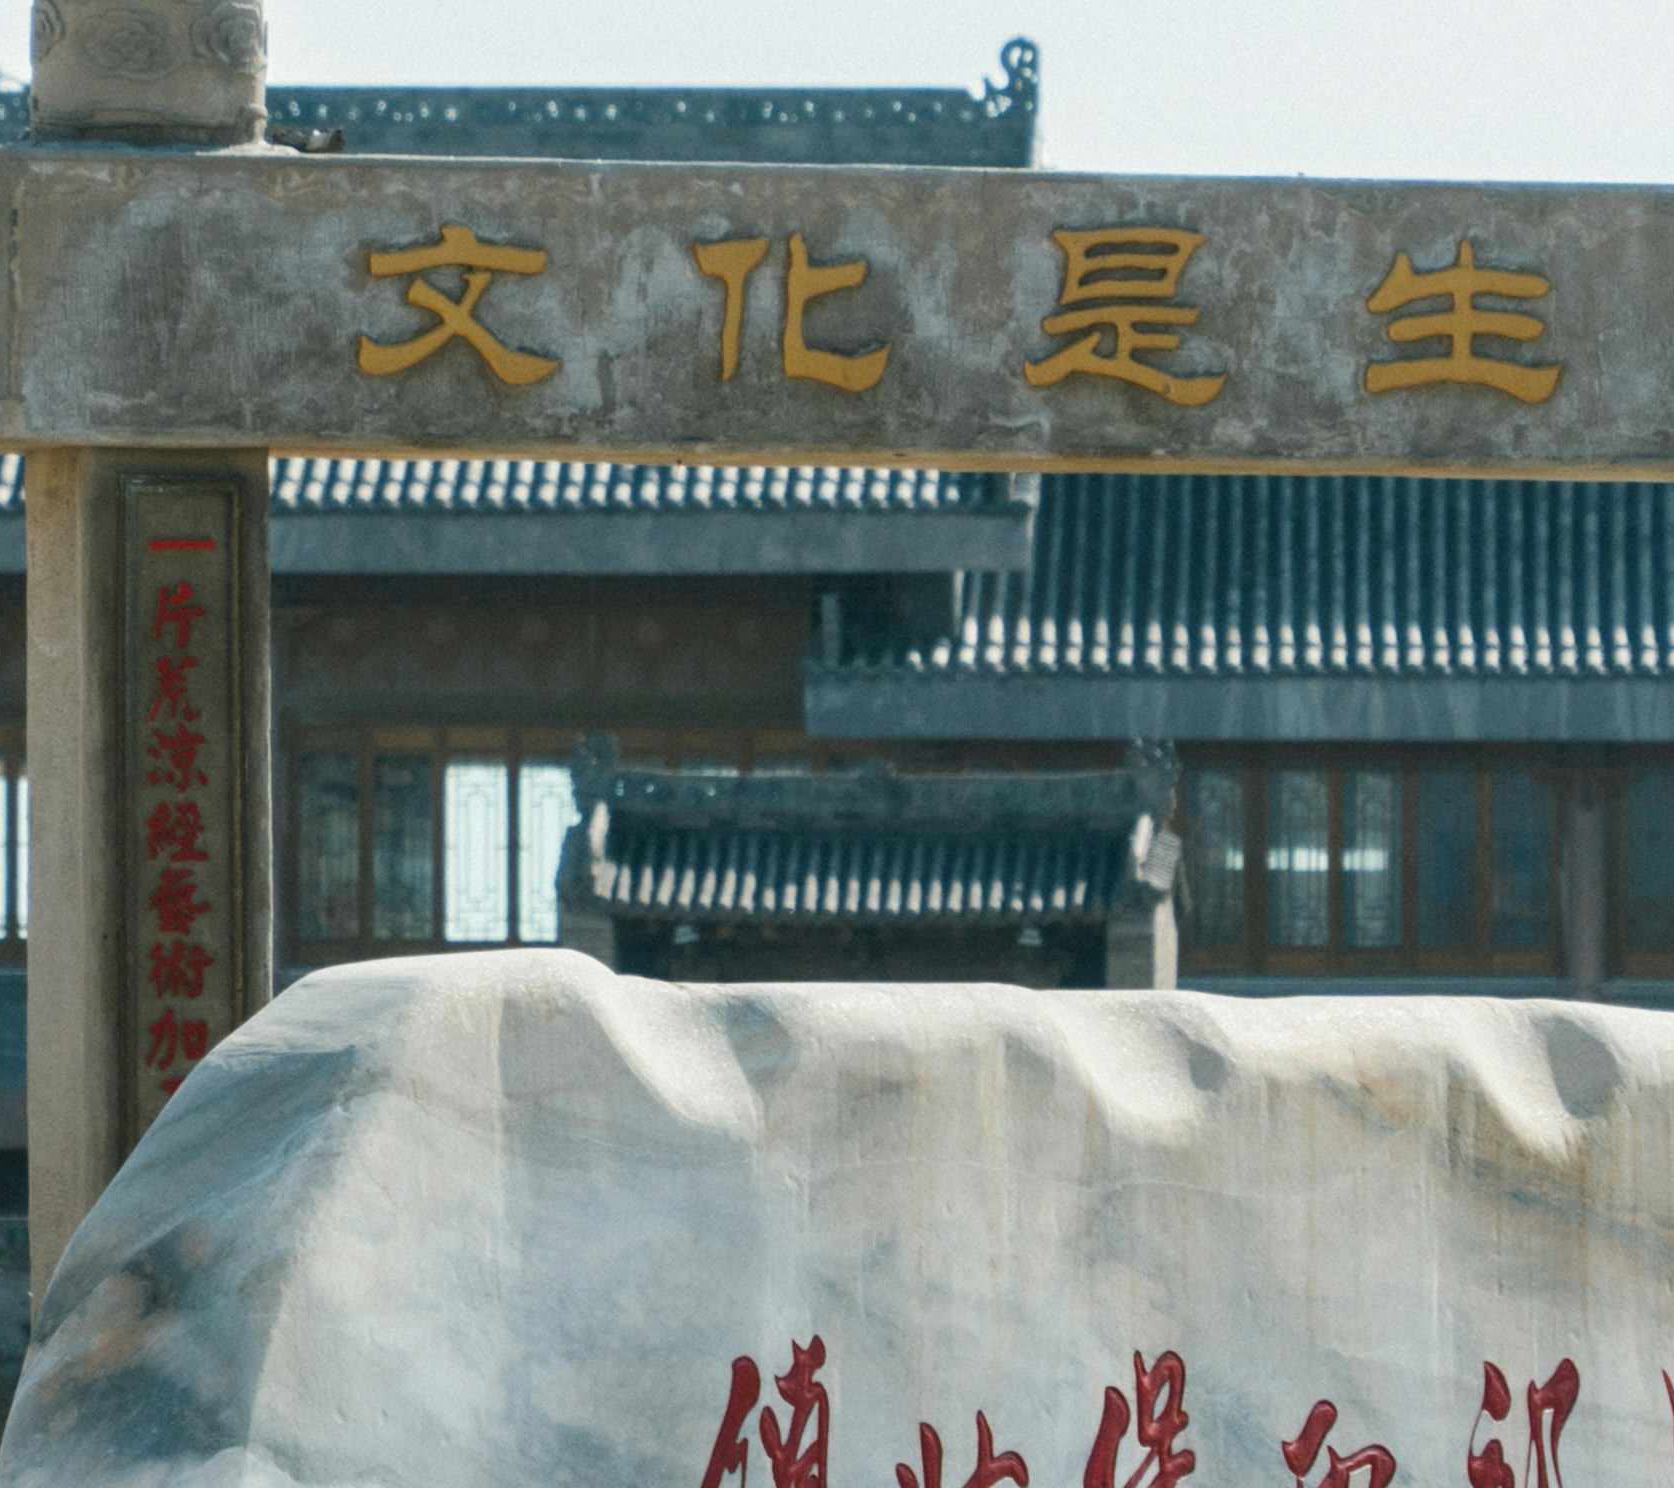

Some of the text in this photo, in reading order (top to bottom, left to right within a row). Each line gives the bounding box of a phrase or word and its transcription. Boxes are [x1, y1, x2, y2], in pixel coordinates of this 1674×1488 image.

[146, 538, 218, 1094] 一片荒涼經藝術加
